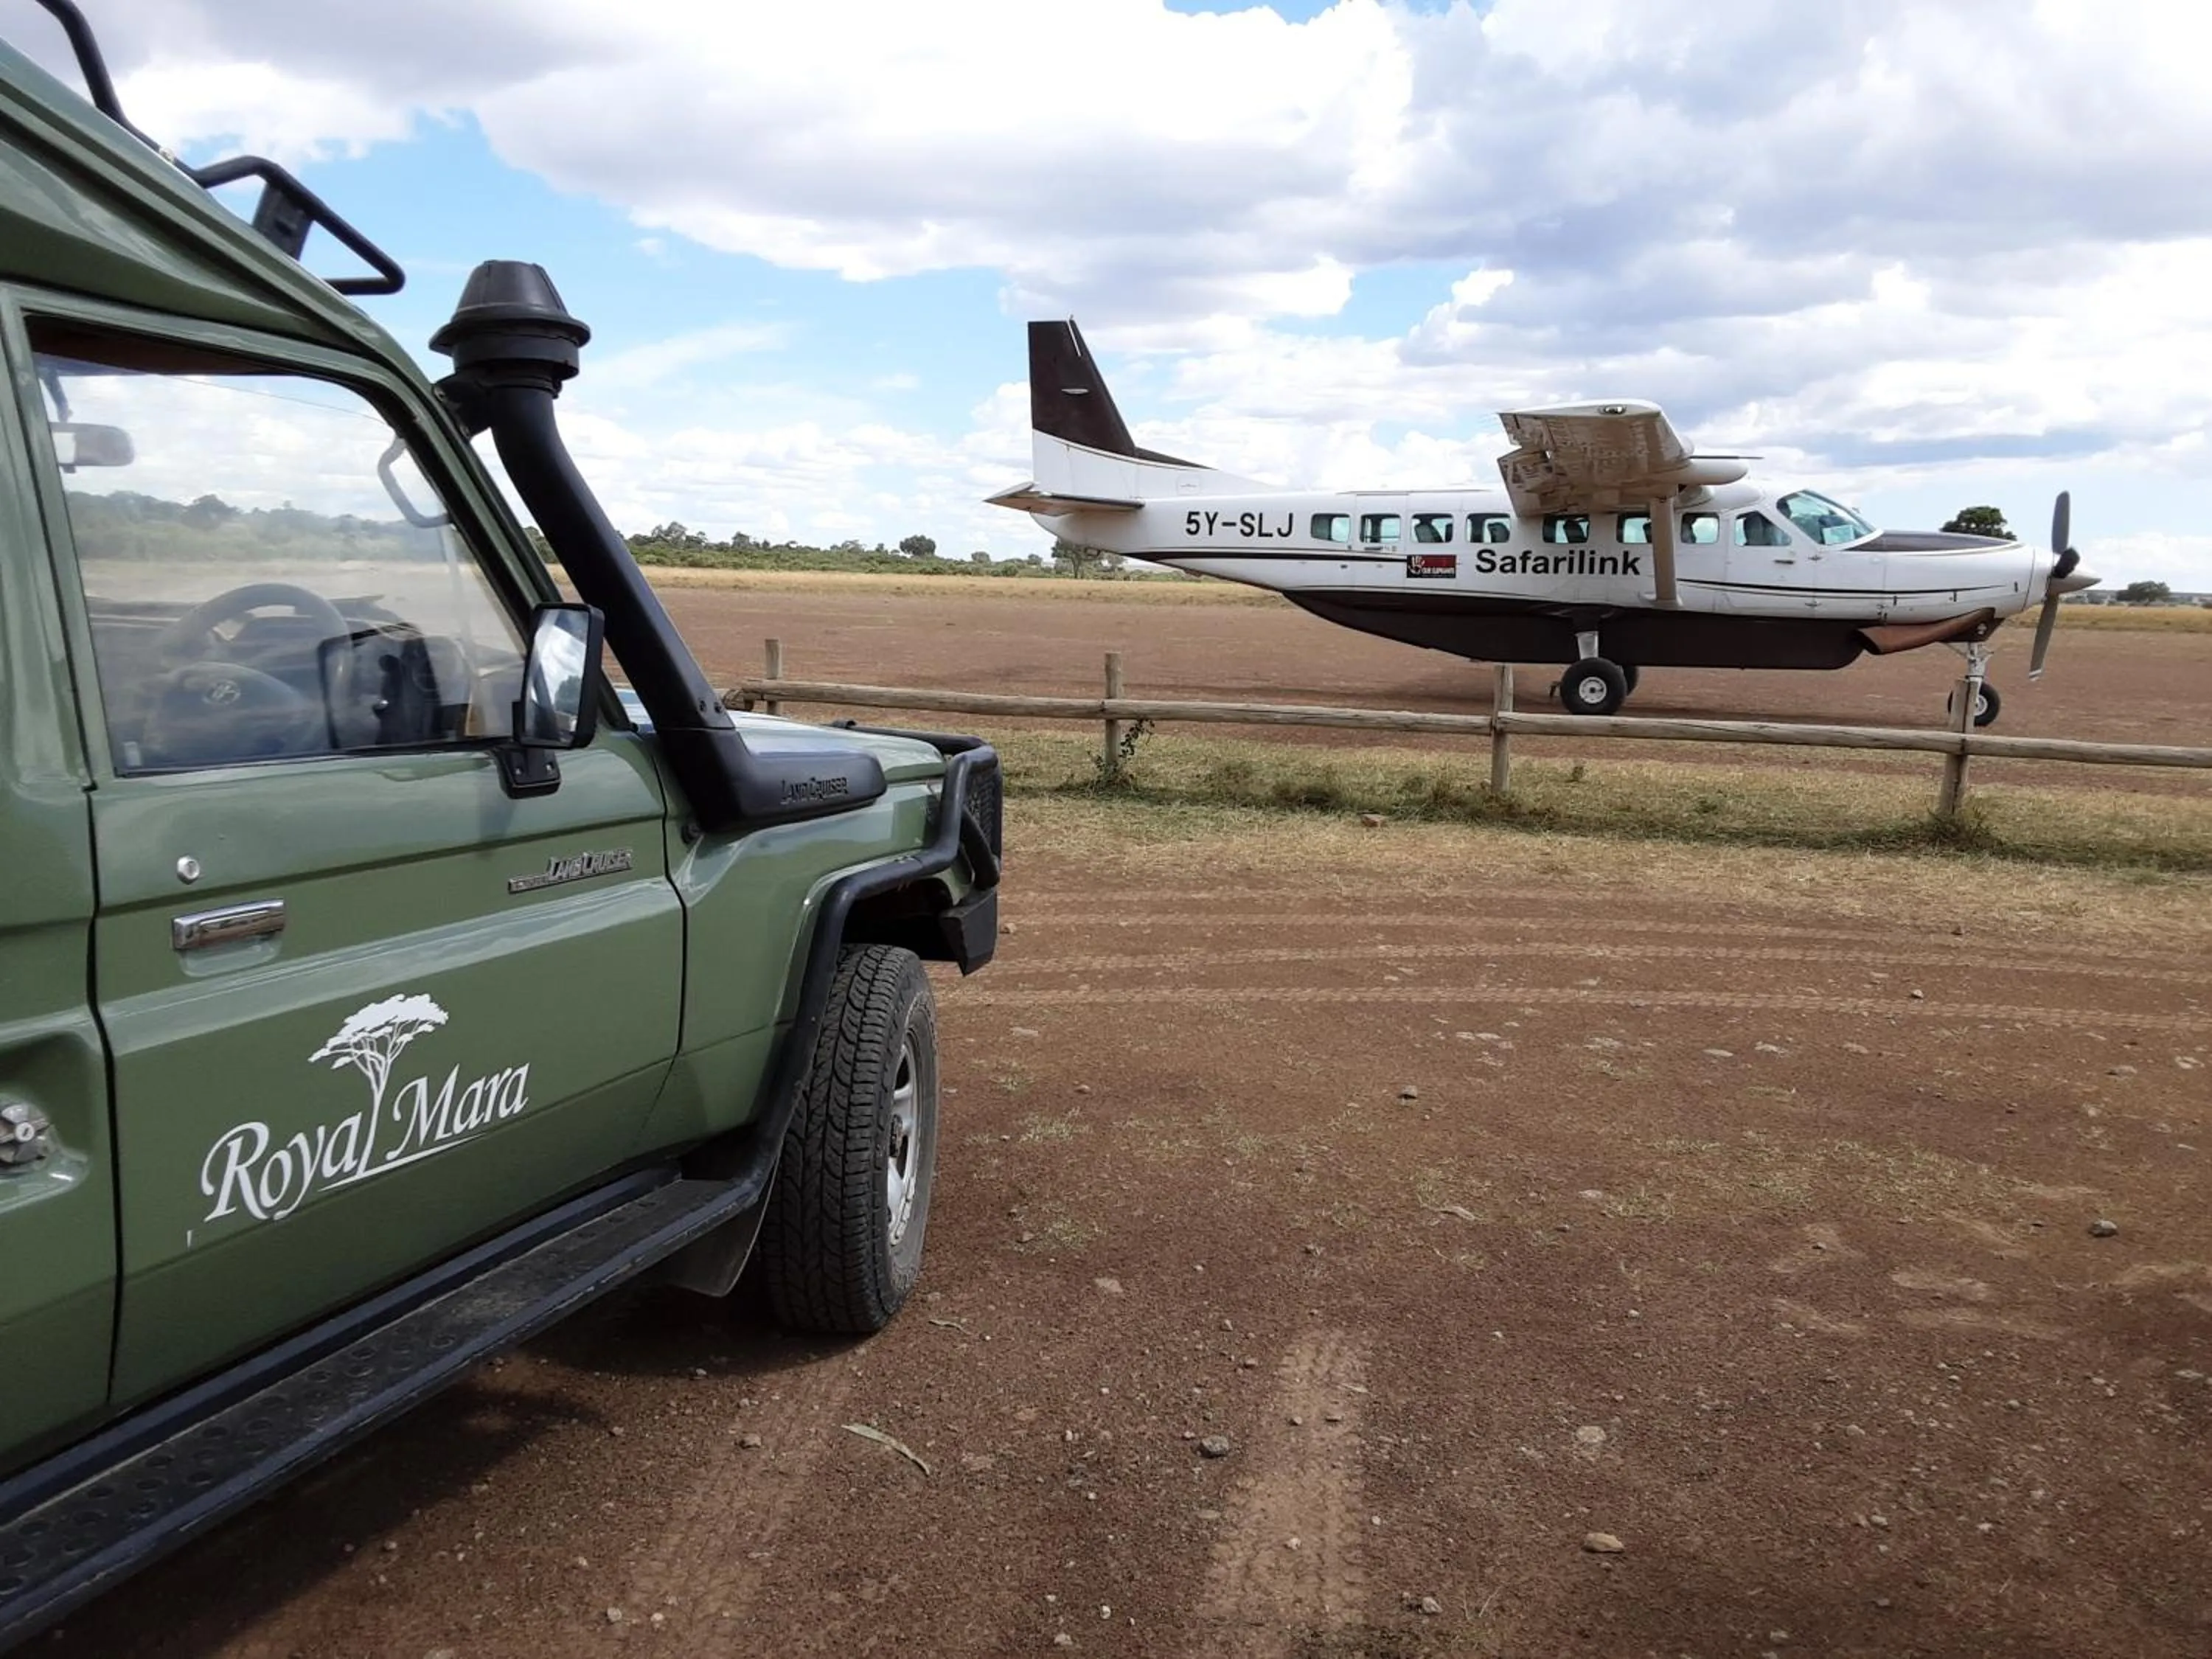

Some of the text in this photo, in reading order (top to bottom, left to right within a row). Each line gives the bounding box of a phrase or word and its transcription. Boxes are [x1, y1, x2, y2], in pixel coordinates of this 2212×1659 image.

[1185, 511, 1293, 538] 5Y-SLJ
[1475, 549, 1641, 576] Safarilink
[386, 1062, 530, 1161] Mara
